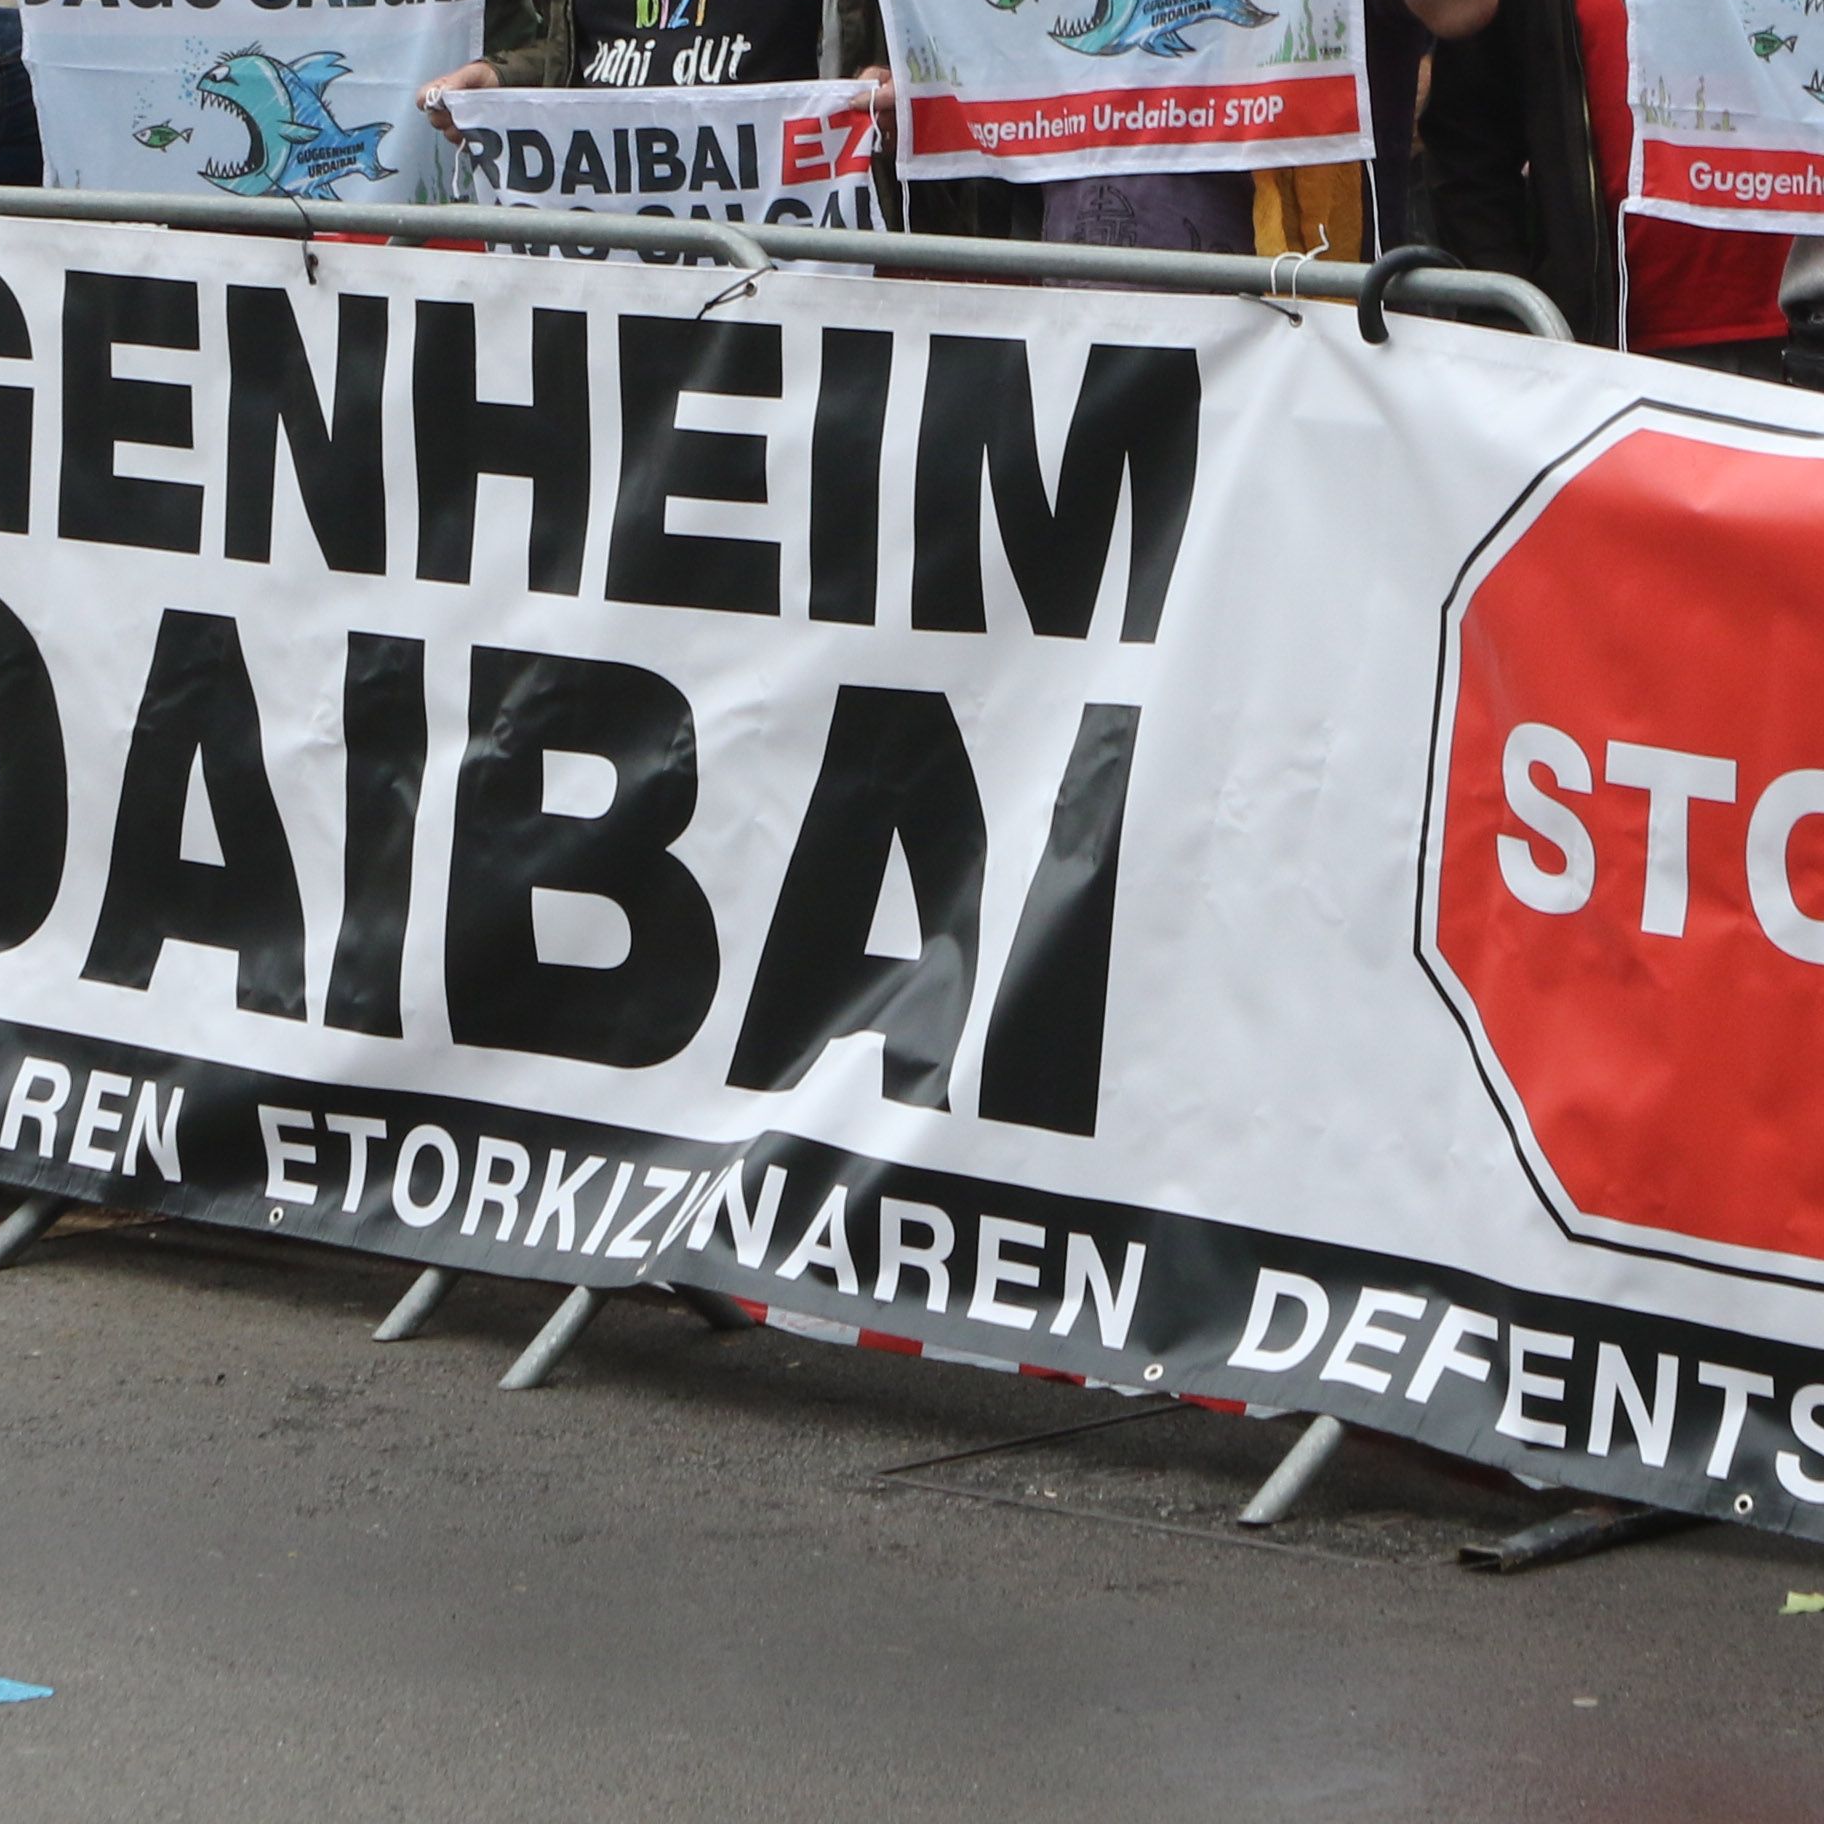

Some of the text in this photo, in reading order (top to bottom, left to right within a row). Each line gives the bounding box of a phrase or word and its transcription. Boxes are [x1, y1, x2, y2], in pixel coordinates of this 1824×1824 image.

[672, 33, 752, 86] dut
[1093, 97, 1216, 132] Urdaibai
[1223, 95, 1284, 127] STOP
[297, 142, 365, 165] GUGGENHEIM
[462, 110, 873, 199] RDAIBAI EZ
